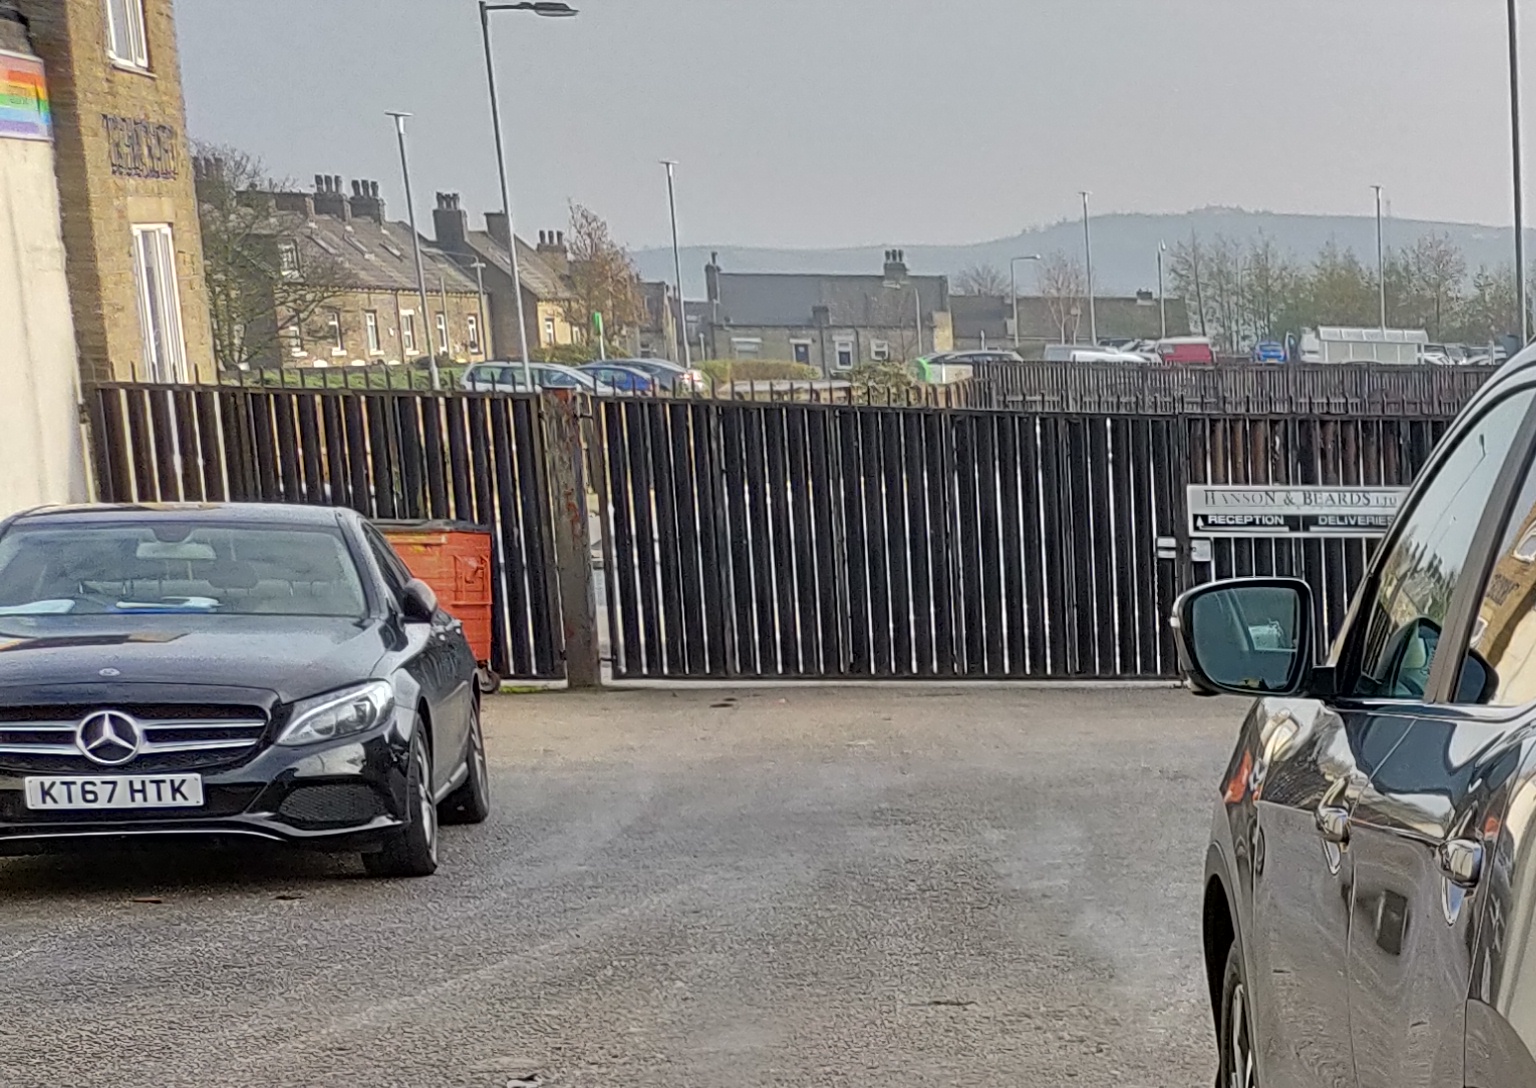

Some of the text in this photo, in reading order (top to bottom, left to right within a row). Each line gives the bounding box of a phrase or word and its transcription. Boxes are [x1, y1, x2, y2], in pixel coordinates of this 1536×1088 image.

[1204, 490, 1276, 505] HANSON
[1284, 491, 1296, 506] &
[1303, 490, 1371, 506] BEARDS
[1208, 515, 1285, 525] RECEPTION
[39, 779, 189, 804] KT67 HTK
